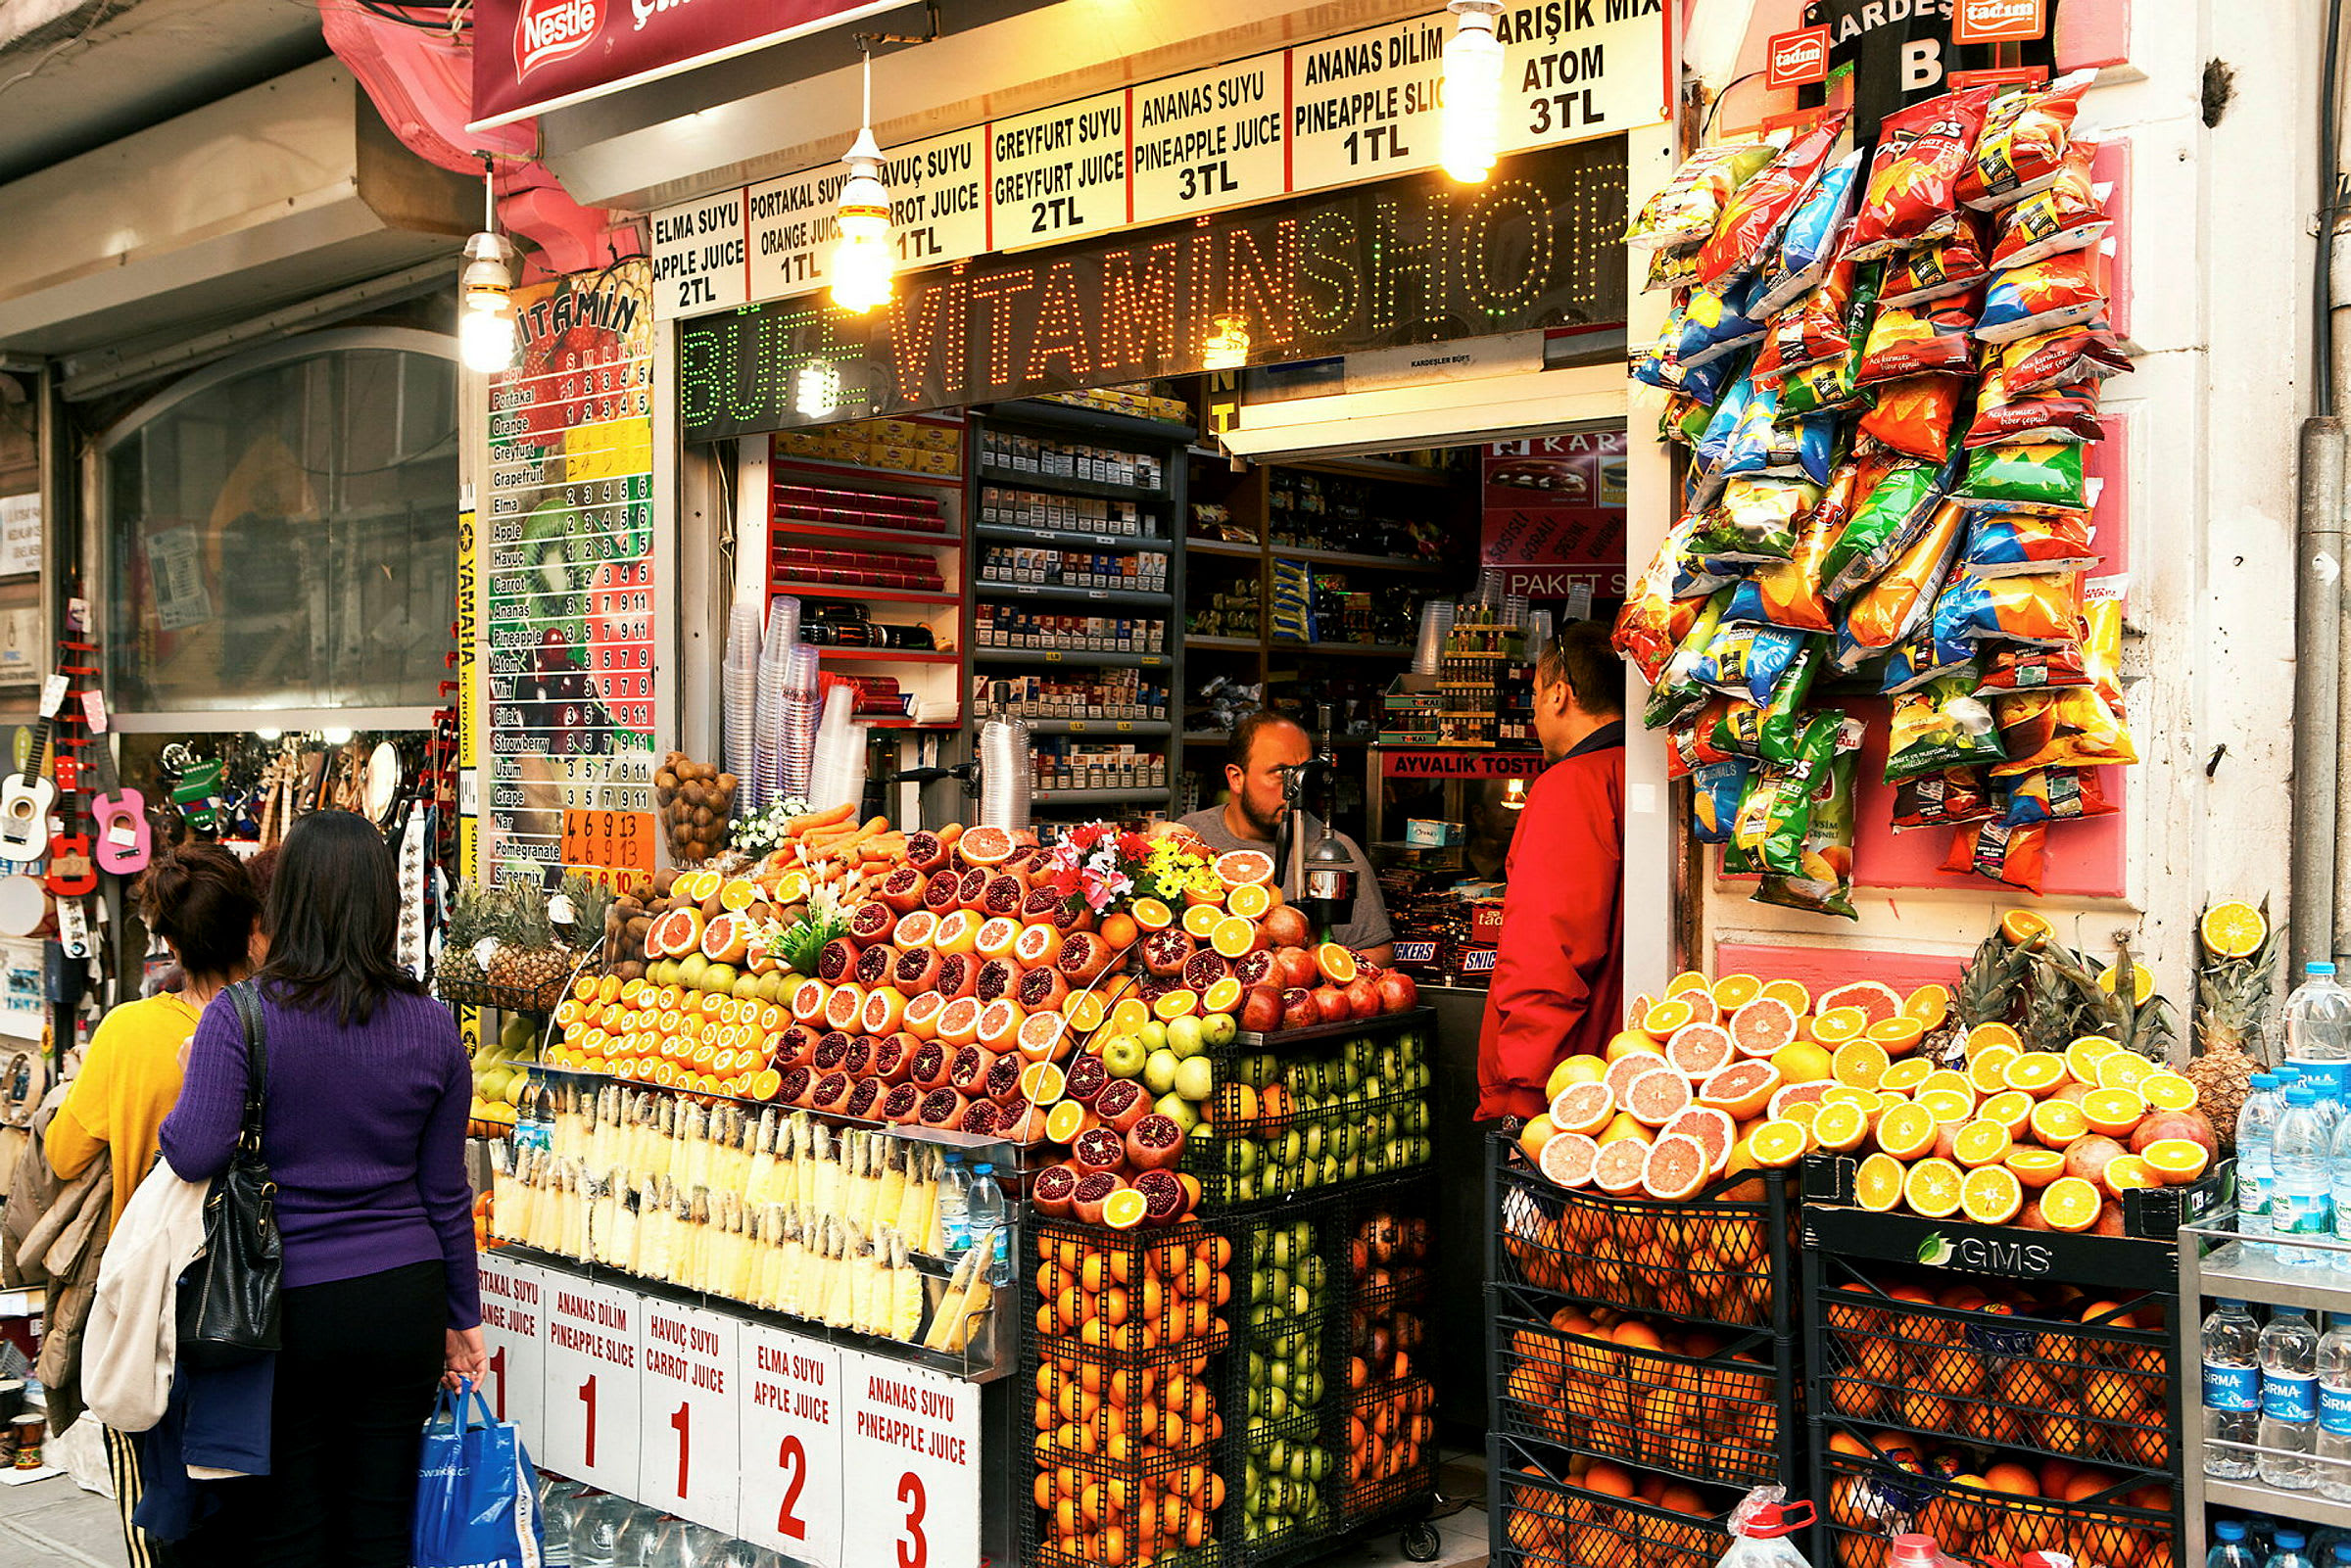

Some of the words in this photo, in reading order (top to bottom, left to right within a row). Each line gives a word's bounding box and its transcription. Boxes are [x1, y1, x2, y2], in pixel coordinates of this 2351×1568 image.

[1497, 0, 1595, 45] ARIŞIK
[1306, 39, 1383, 86] ANANAS
[1389, 23, 1444, 69] DİLİM
[1522, 44, 1605, 93] ATOM
[1142, 84, 1213, 128] ANANAS
[1219, 71, 1265, 109] SUYU
[1296, 86, 1398, 136] PINEAPPLE
[1405, 76, 1446, 116] SLIC
[1530, 88, 1606, 134] 3TL
[995, 118, 1074, 163] GREYFURT
[1080, 107, 1122, 143] SUYU
[1135, 122, 1226, 173] PINEAPPLE
[1232, 112, 1281, 152] JUICE
[1343, 124, 1410, 166] 1TL
[878, 155, 923, 189] AVUÇ
[928, 142, 972, 179] SUYU
[995, 163, 1074, 206] GREYFURT
[1079, 151, 1125, 188] JUICE
[1178, 161, 1238, 201] 3TL
[750, 182, 814, 221] PORTAKAL
[932, 182, 979, 218] JUICE
[1032, 196, 1083, 233] 2TL
[656, 214, 695, 245] ELMA
[698, 202, 739, 235] SUYU
[761, 222, 807, 256] ORANGE
[896, 227, 942, 261] 1TL
[652, 250, 696, 282] APPLE
[700, 239, 744, 271] JUICE
[781, 252, 822, 284] 1TL
[679, 276, 716, 308] 2TL
[513, 284, 639, 346] İTAMİN
[494, 388, 535, 409] Portakal
[567, 378, 574, 396] 1
[584, 376, 593, 393] 2
[603, 373, 610, 389] 3
[621, 369, 627, 385] 4
[639, 366, 646, 383] 5
[494, 418, 529, 436] Orange
[1544, 433, 1627, 452] KAR
[494, 443, 535, 461] Greyfurt
[494, 468, 544, 488] Grapefruit
[494, 499, 518, 513] Elma
[567, 489, 574, 504] 2
[585, 487, 592, 502] 3
[603, 484, 610, 500] 4
[621, 482, 628, 498] 5
[639, 480, 646, 497] 6
[494, 525, 522, 542] Apple
[494, 576, 525, 593] Carrot
[459, 558, 476, 667] YAMAHA
[494, 603, 530, 618] Ananas
[567, 598, 574, 614] 3
[585, 597, 592, 613] 5
[603, 595, 610, 611] 7
[621, 594, 628, 610] 9
[494, 628, 543, 646] Pineapple
[494, 655, 520, 671] Atom
[494, 684, 512, 699] Mix
[460, 672, 469, 762] KEYBOARDS
[1394, 756, 1476, 774] AYVALIK
[495, 786, 525, 806] Grape
[495, 813, 513, 831] Nar
[495, 840, 560, 861] Pomegranate
[1960, 1238, 2053, 1274] GMS
[479, 1269, 511, 1298] RTAKAL
[514, 1279, 539, 1307] SUYU
[482, 1303, 505, 1330] ANGE
[507, 1309, 536, 1338] JUICE
[557, 1291, 597, 1324] ANANAS
[599, 1300, 627, 1332] DİLİM
[551, 1322, 603, 1359] PINEAPPLE
[605, 1338, 635, 1369] SLICE
[650, 1314, 688, 1353] HAVUÇ
[691, 1326, 719, 1357] SUYU
[490, 1346, 505, 1423] 1
[647, 1348, 689, 1383] CARROT
[692, 1362, 725, 1395] JUICE
[757, 1345, 790, 1377] ELMA
[792, 1354, 824, 1387] SUYU
[754, 1380, 790, 1413] APPLE
[793, 1392, 829, 1425] JUICE
[868, 1375, 917, 1413] ANANAS
[921, 1389, 954, 1423] SUYU
[579, 1373, 597, 1469] 1
[857, 1410, 925, 1454] PINEAPPLE
[928, 1432, 966, 1466] JUICE
[671, 1401, 690, 1500] 1
[777, 1435, 806, 1542] 2
[896, 1471, 928, 1568] 3
